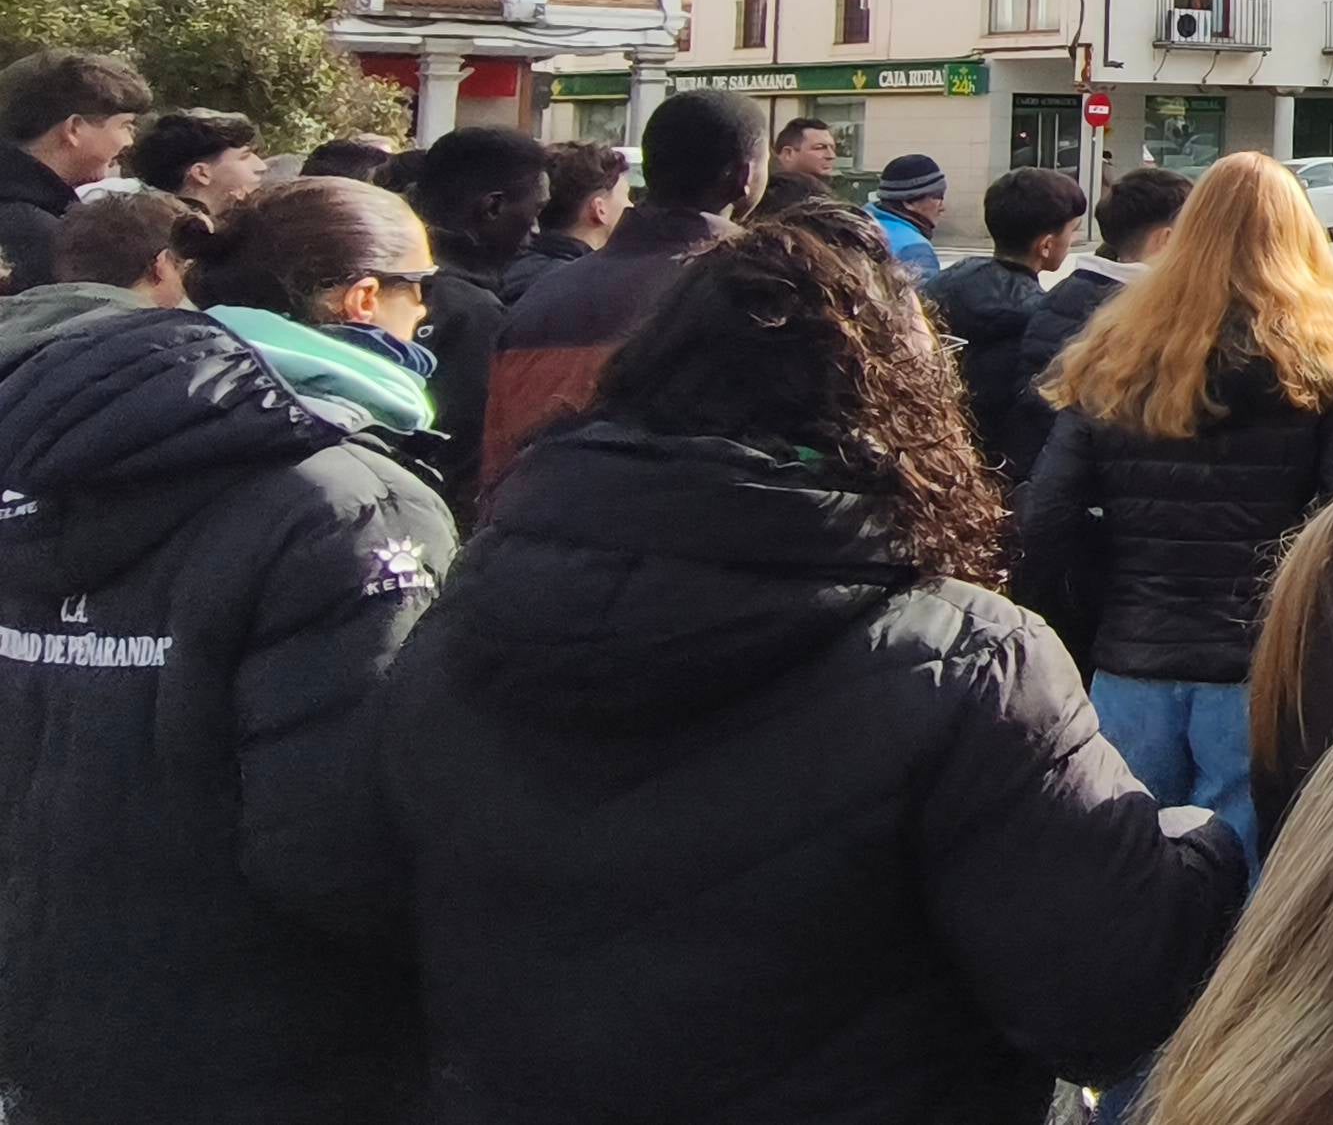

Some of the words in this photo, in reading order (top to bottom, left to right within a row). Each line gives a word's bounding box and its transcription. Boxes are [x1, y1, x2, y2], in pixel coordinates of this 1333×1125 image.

[712, 76, 728, 92] DE
[728, 74, 798, 91] SALAMANCA
[879, 70, 907, 87] CAJA
[908, 69, 945, 86] RURA
[43, 634, 66, 664] DE
